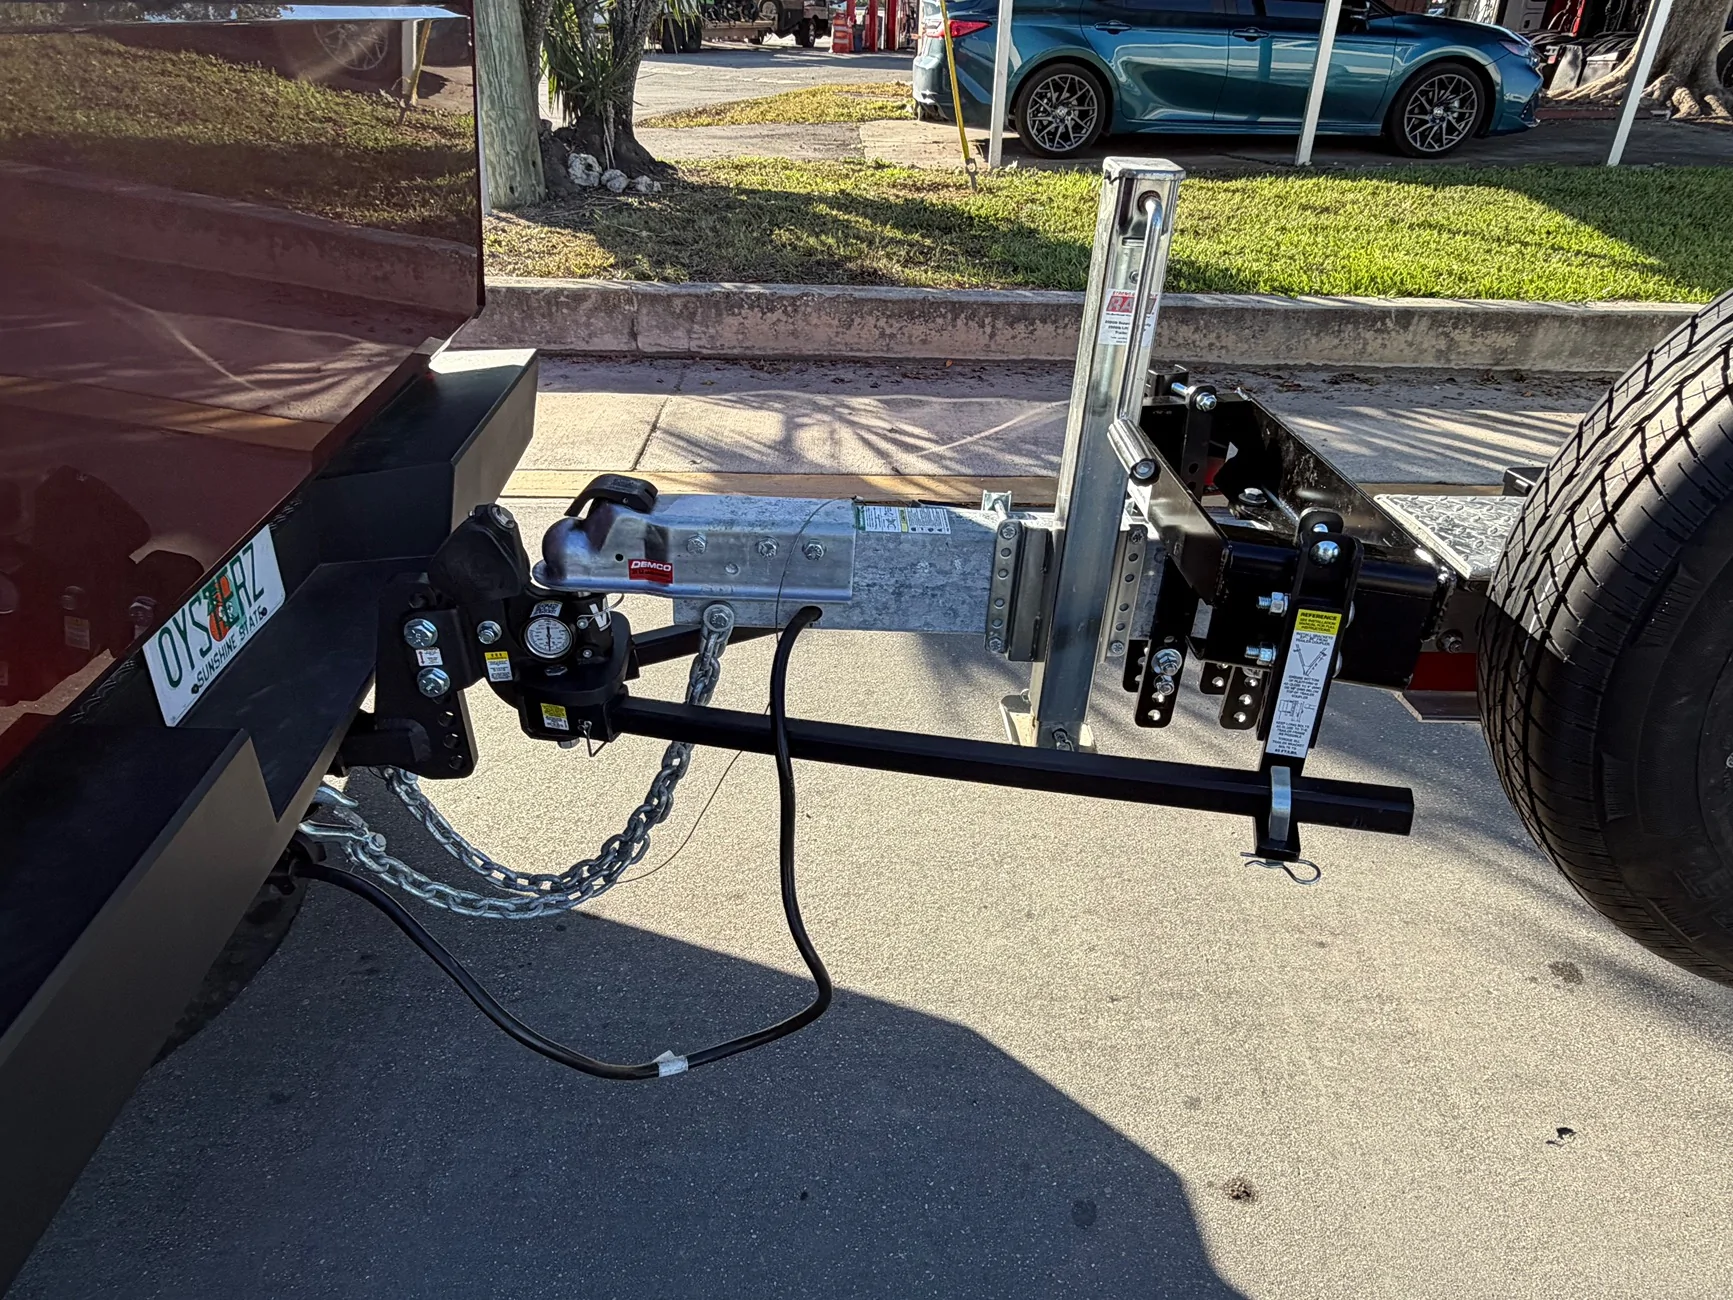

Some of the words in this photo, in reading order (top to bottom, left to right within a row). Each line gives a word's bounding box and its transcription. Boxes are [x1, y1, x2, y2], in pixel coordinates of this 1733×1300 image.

[631, 561, 671, 571] DEMCO
[1301, 612, 1337, 620] REFERENCE
[196, 637, 238, 688] SUNSHINE
[240, 607, 263, 641] STATE
